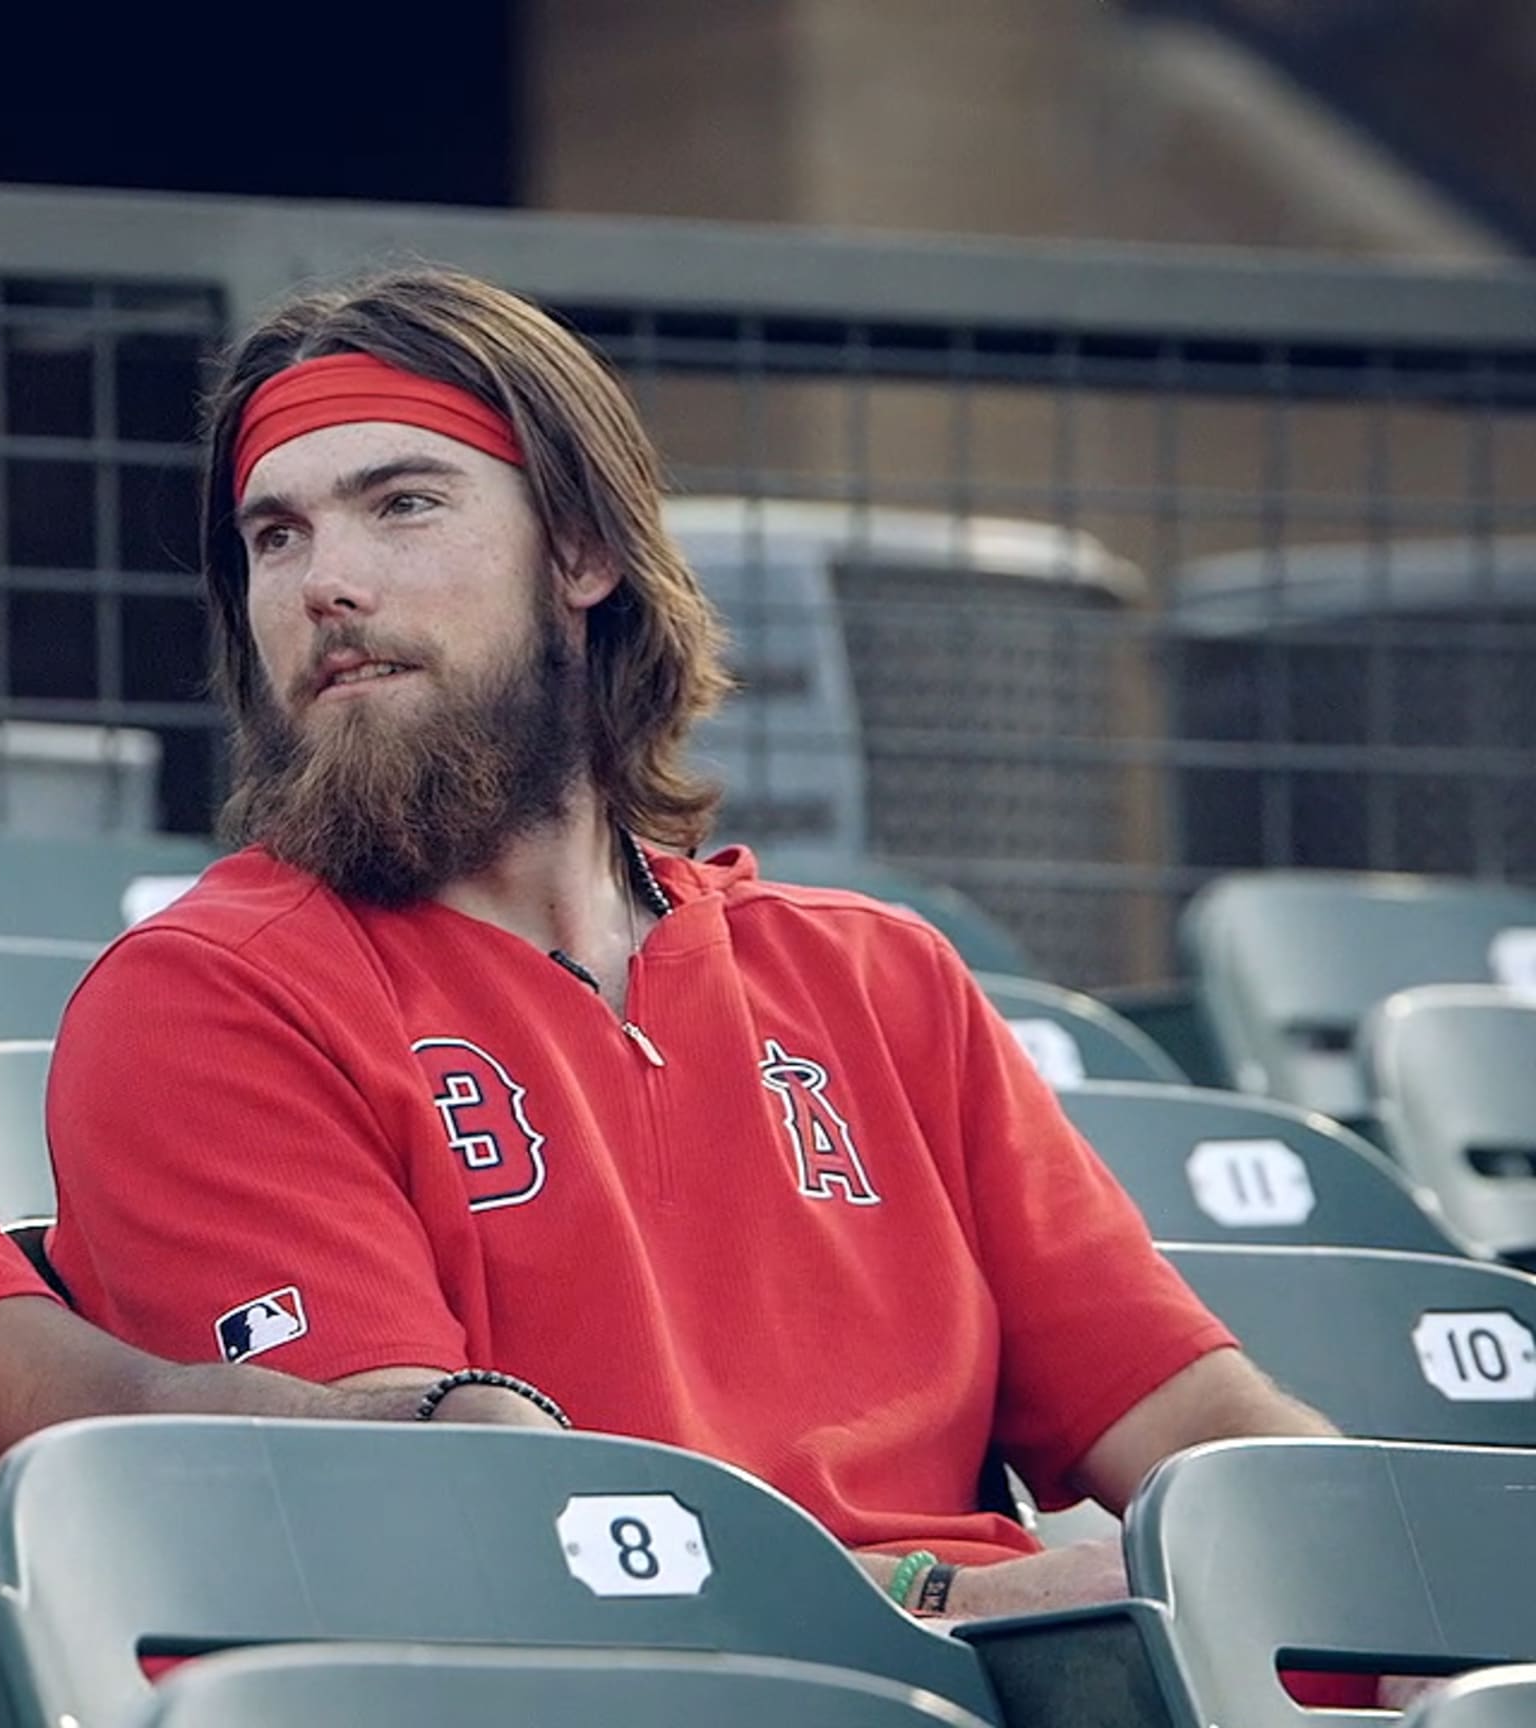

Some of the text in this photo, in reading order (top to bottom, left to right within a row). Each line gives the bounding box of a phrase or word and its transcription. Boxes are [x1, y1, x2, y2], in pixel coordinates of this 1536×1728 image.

[760, 1040, 880, 1204] A
[1226, 1156, 1278, 1208] 11
[1446, 1327, 1509, 1382] 10
[608, 1515, 660, 1581] 8
